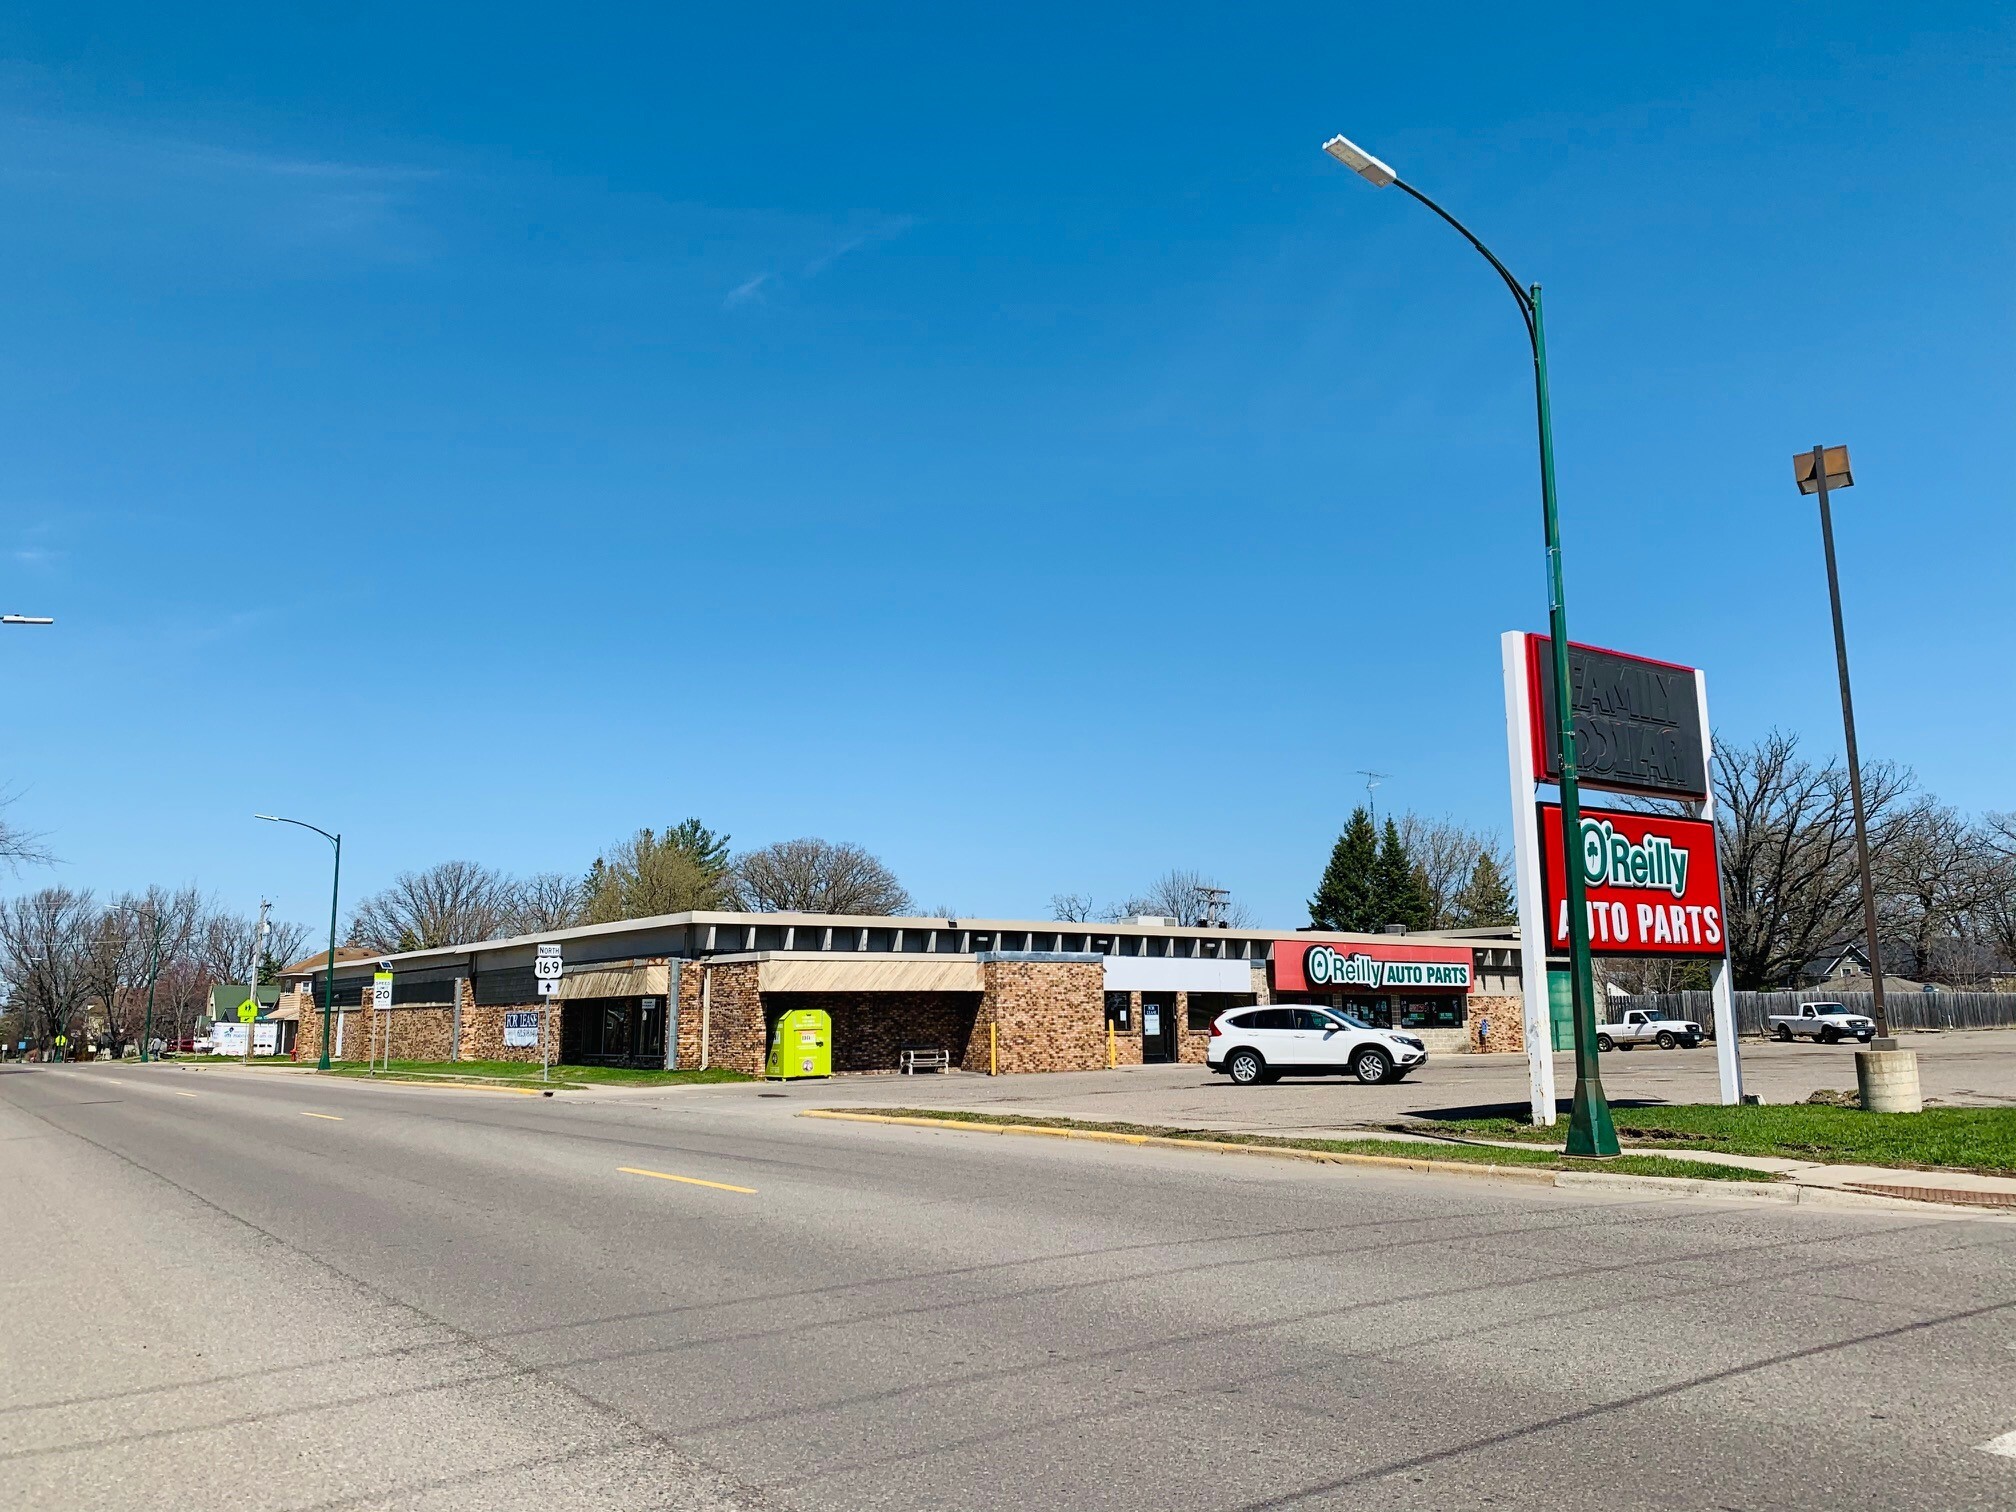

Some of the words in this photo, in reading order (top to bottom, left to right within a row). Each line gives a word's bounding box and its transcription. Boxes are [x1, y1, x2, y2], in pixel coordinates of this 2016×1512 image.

[1581, 822, 1687, 894] O'Reilly
[1636, 903, 1722, 945] PARTS
[539, 947, 560, 955] NORTH
[539, 961, 559, 974] 169
[1311, 949, 1381, 986] O'Reilly
[1386, 966, 1423, 984] AUTO
[1427, 966, 1467, 984] PARTS
[375, 990, 390, 999] 20
[506, 1014, 518, 1028] FOR
[520, 1013, 538, 1027] LEASE
